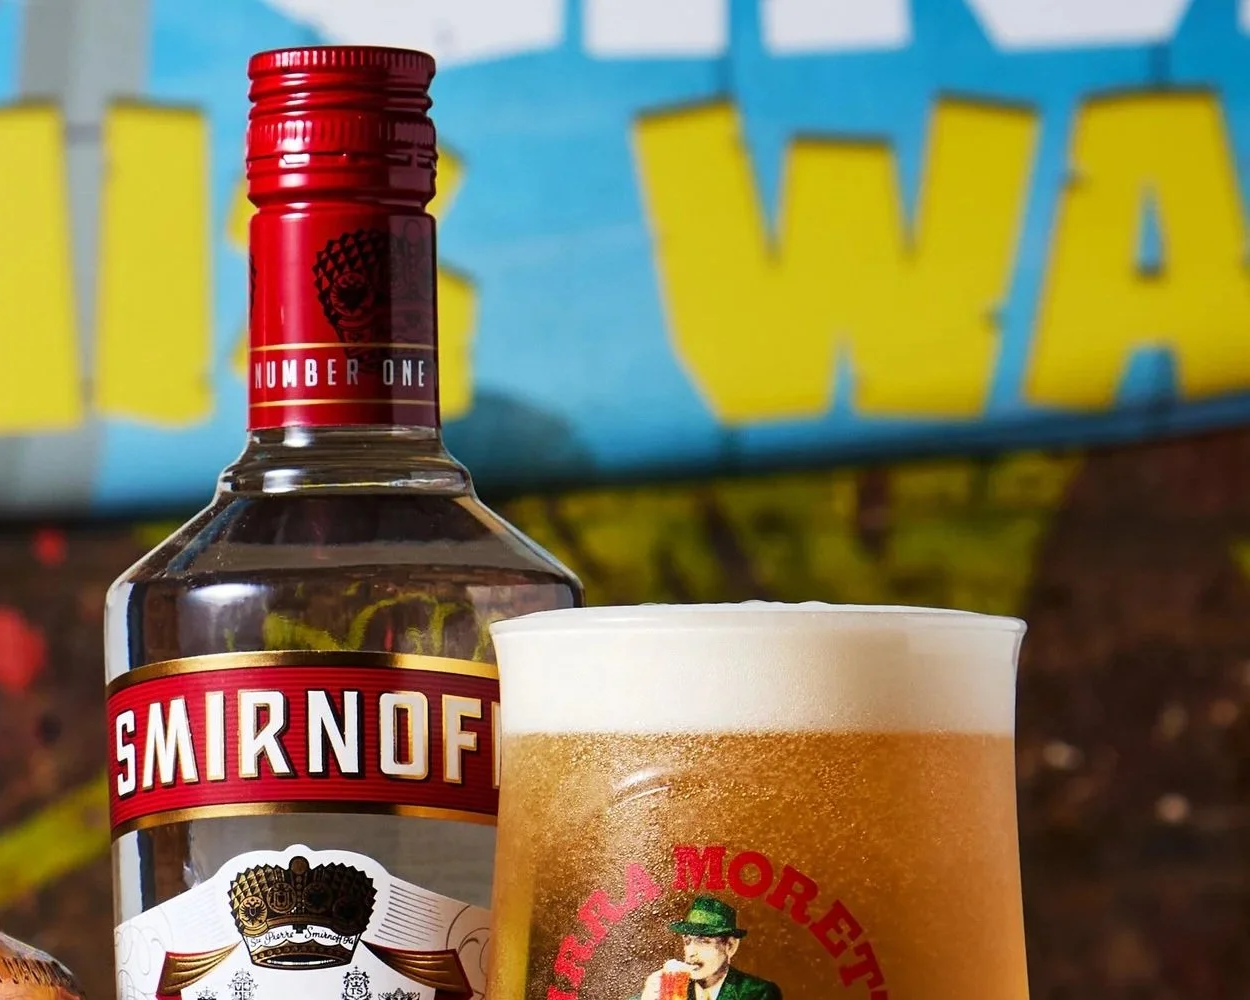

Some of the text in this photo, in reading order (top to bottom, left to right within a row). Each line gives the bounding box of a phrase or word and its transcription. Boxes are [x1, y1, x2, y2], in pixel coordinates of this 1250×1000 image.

[633, 90, 1250, 424] WA
[255, 359, 425, 388] NUMBER ONE
[115, 688, 500, 798] SMIRNOF
